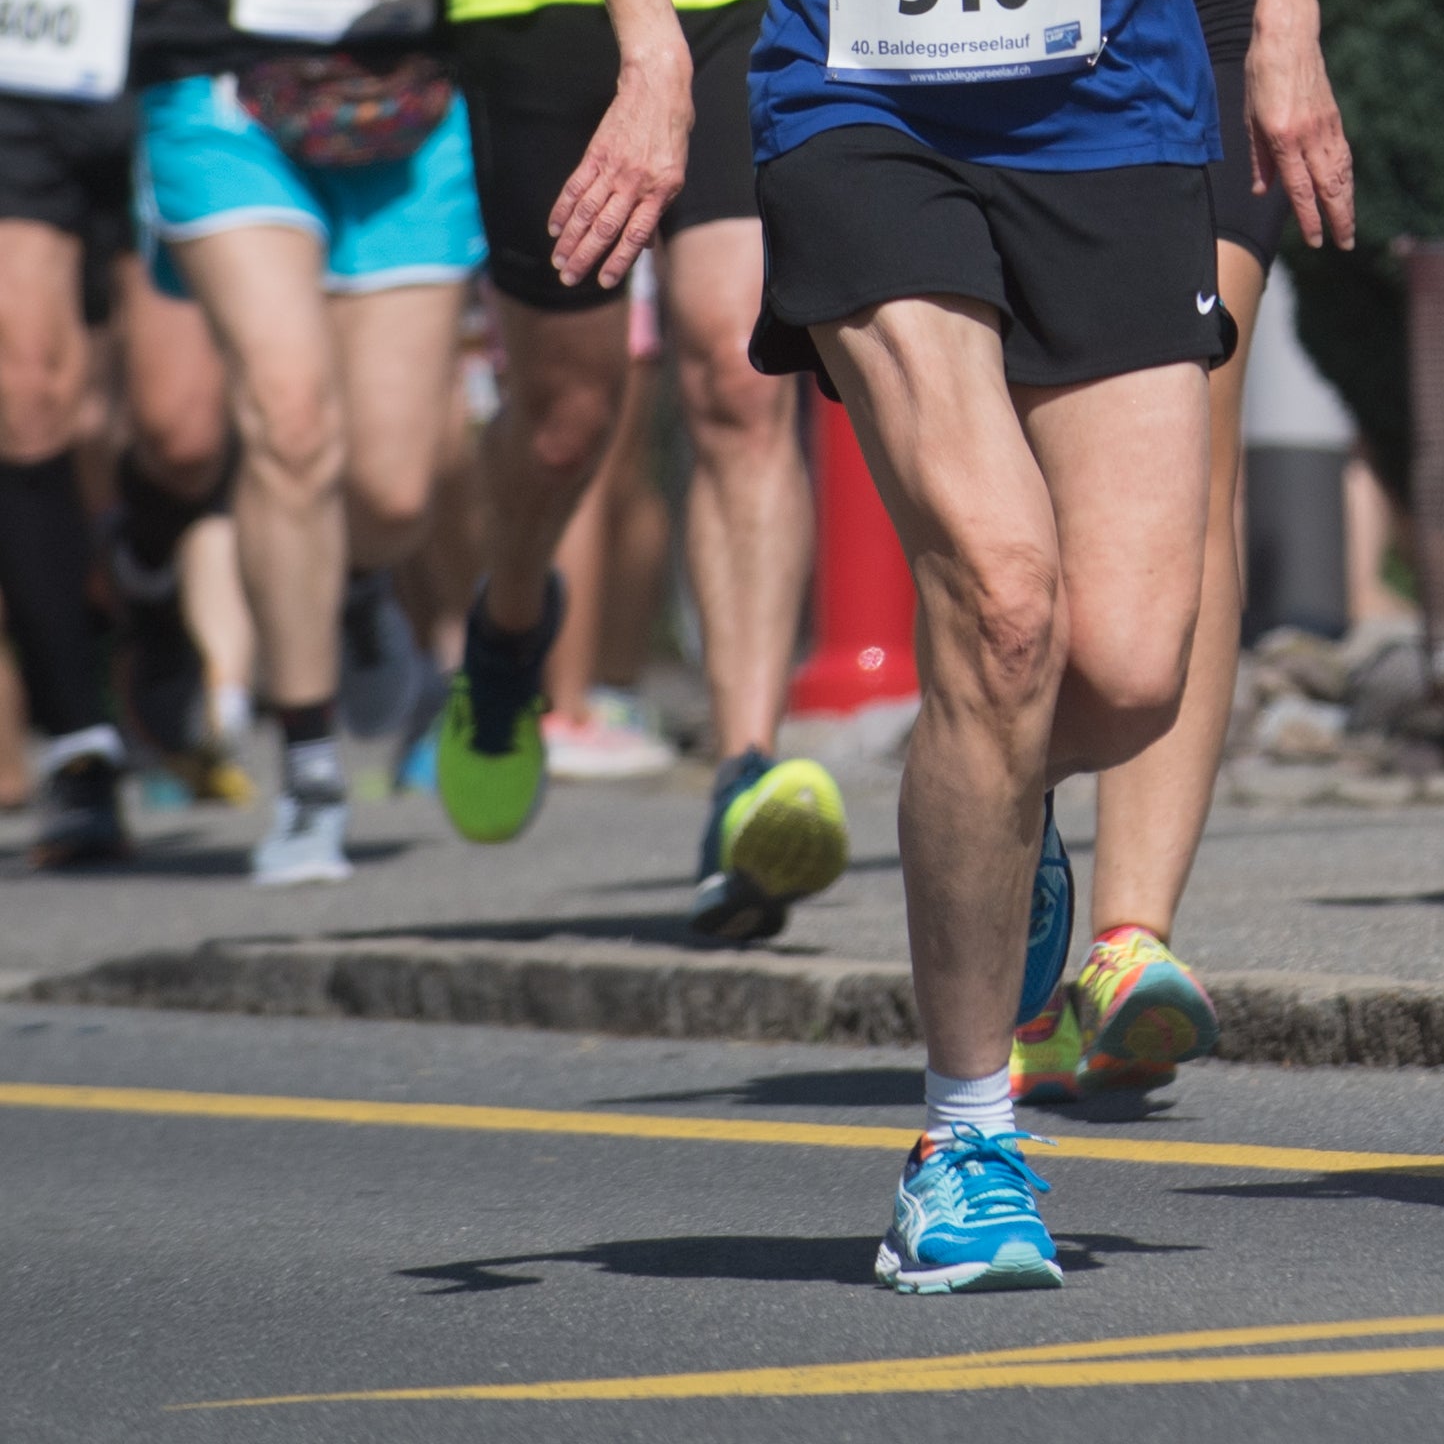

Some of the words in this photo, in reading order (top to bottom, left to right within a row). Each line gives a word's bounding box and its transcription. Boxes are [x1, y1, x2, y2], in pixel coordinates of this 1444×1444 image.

[851, 40, 874, 55] 40.
[878, 33, 1030, 57] Baldeggerseelauf
[909, 64, 1031, 83] www.baldeggerseelauf.ch
